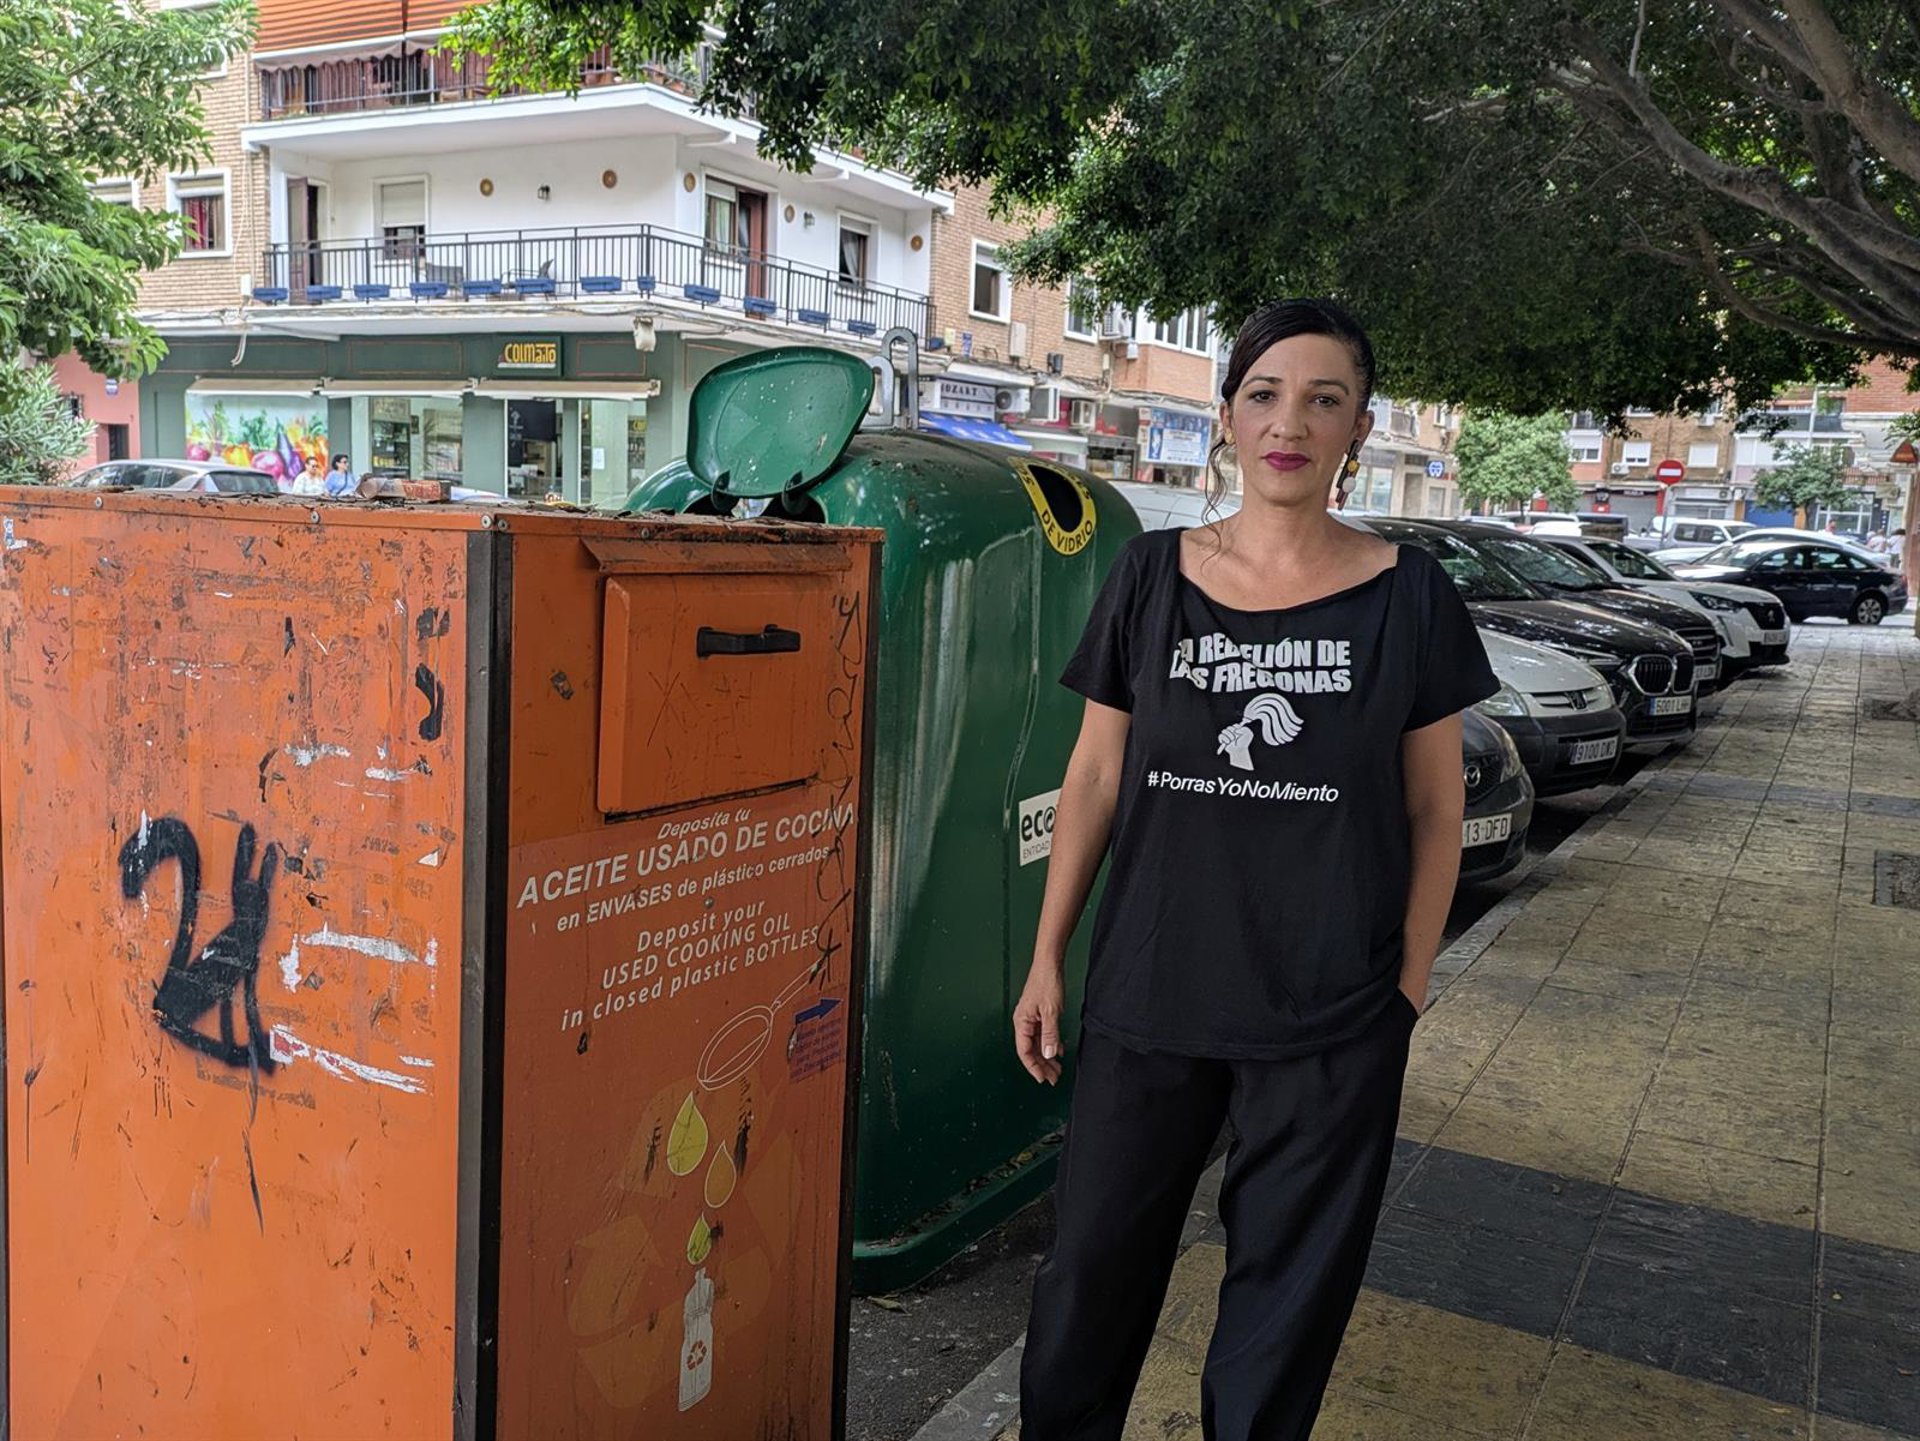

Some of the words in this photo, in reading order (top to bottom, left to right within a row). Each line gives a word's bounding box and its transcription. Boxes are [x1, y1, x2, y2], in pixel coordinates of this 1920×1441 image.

[1042, 509, 1056, 536] DE
[1056, 520, 1093, 552] VIDRIO
[1170, 649, 1209, 690] LAS
[1317, 640, 1351, 667] DE
[1147, 771, 1339, 802] #PorrasYoNoMiento
[657, 812, 729, 840] Deposita
[735, 808, 751, 823] tu
[516, 854, 629, 909] ACEITE
[637, 831, 728, 876] USADO
[736, 822, 769, 852] DE
[776, 803, 854, 842] COCINA
[557, 912, 580, 932] en
[587, 882, 672, 923] ENVASES
[677, 878, 698, 897] de
[702, 863, 764, 895] plástico
[768, 845, 830, 873] cerrados
[603, 955, 659, 989] USED
[667, 925, 756, 969] COOKING
[763, 912, 791, 937] OIL
[637, 913, 717, 953] Deposit
[723, 901, 766, 932] your
[561, 1009, 583, 1031] in
[593, 977, 663, 1020] closed
[670, 956, 738, 998] plastic
[745, 925, 819, 967] BOTTLES
